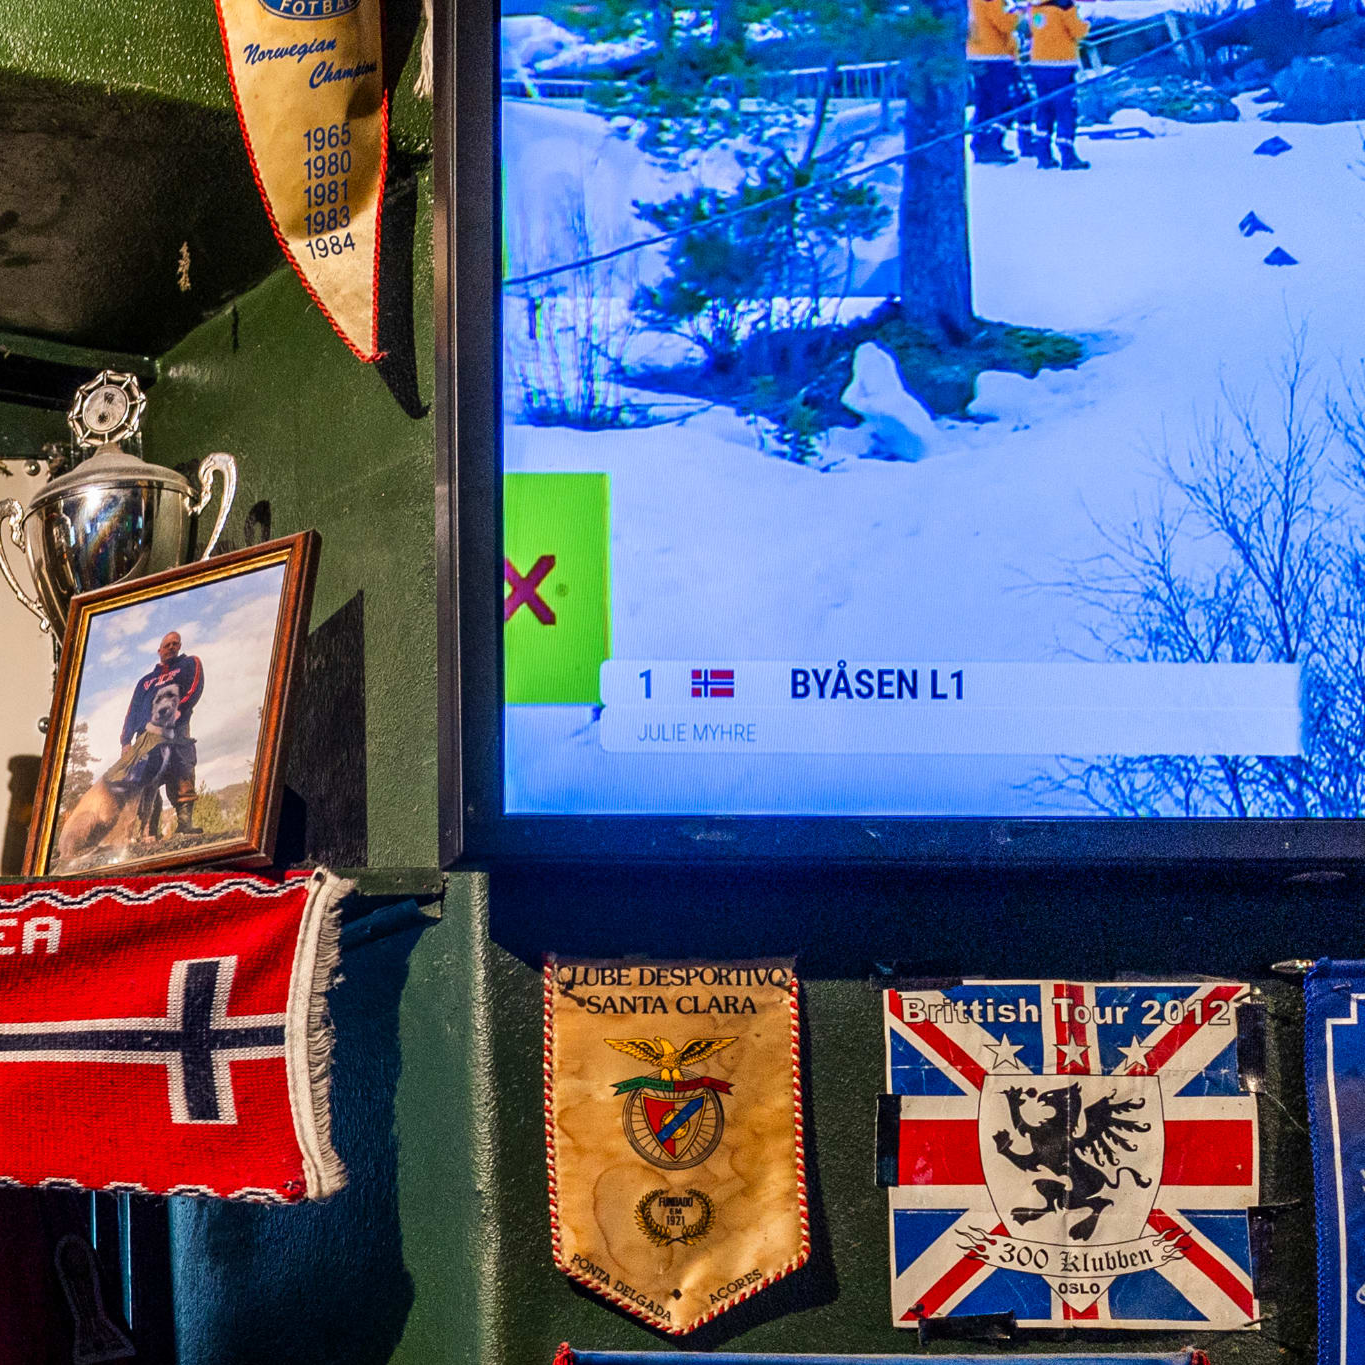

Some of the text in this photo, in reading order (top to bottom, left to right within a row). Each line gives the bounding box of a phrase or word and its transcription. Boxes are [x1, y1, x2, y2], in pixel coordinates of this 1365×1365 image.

[243, 37, 337, 65] Norwegian
[303, 122, 352, 152] 1965
[303, 151, 352, 181] 1980
[303, 181, 350, 208] 1981
[303, 205, 351, 236] 1983
[305, 232, 356, 260] 1984
[638, 659, 965, 701] 1 BYÅSEN L1
[637, 723, 757, 743] JULIE MYHRE
[555, 966, 788, 989] CLUBE DESPORTIVO
[586, 995, 757, 1015] SANTA CLARA
[902, 997, 1231, 1026] Brittish Tour 2012
[658, 1197, 694, 1208] FUNDADO
[666, 1215, 686, 1227] 1921
[999, 1243, 1154, 1273] 300 Klubben
[570, 1252, 672, 1321] PONTA DELGADA
[708, 1268, 763, 1305] AÇORES
[1058, 1282, 1101, 1295] OSLO
